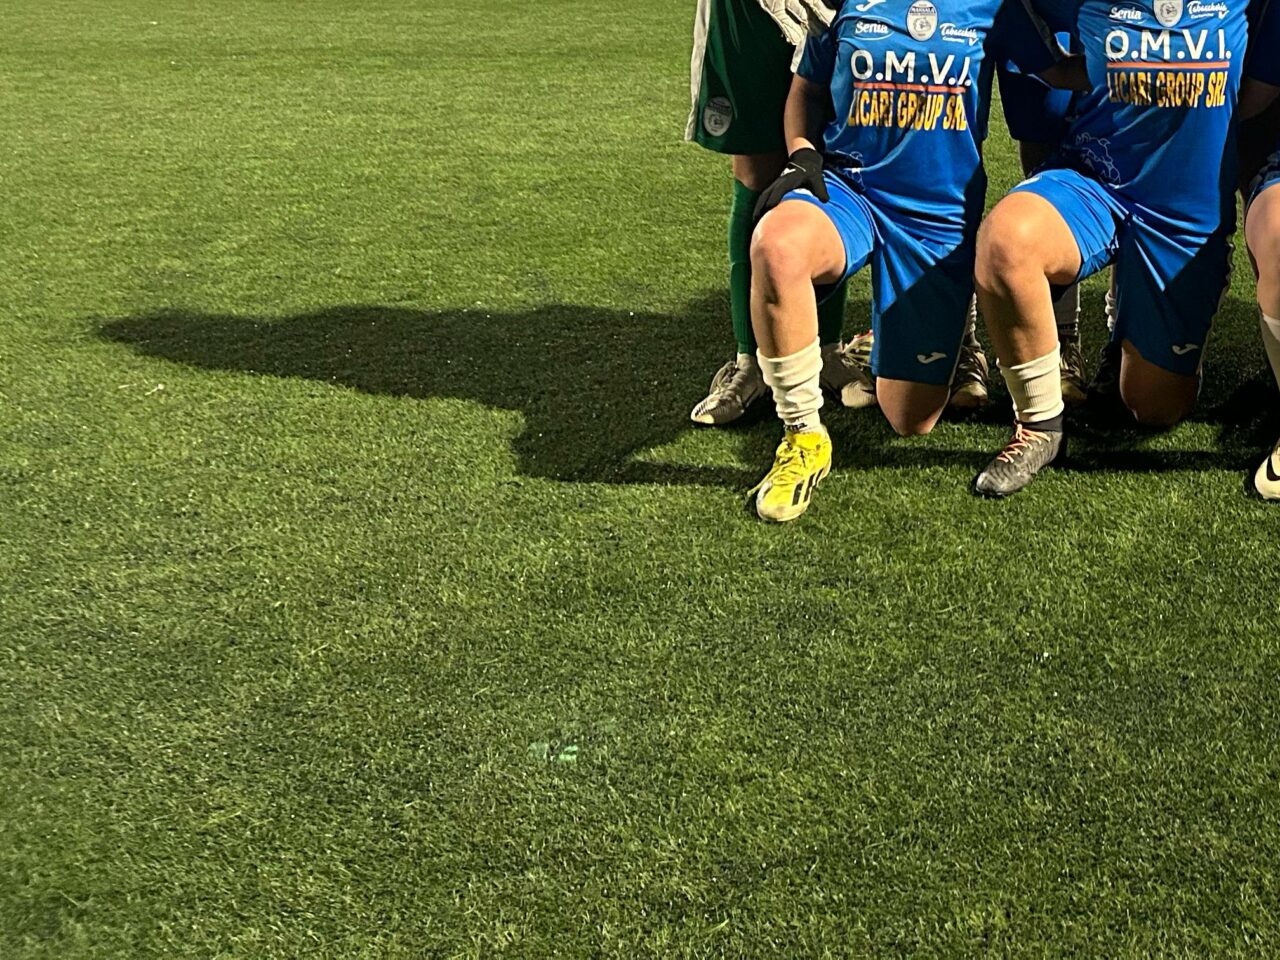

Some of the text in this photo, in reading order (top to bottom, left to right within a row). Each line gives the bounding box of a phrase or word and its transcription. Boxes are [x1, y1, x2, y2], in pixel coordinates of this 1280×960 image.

[855, 21, 888, 35] Senia
[1109, 6, 1143, 20] Senia
[1105, 29, 1232, 60] O.M.V.I.
[851, 49, 972, 87] O.M.V.I.
[1106, 71, 1229, 108] LICARI GROUP SRL
[848, 90, 968, 131] LICARI GROUP SRL
